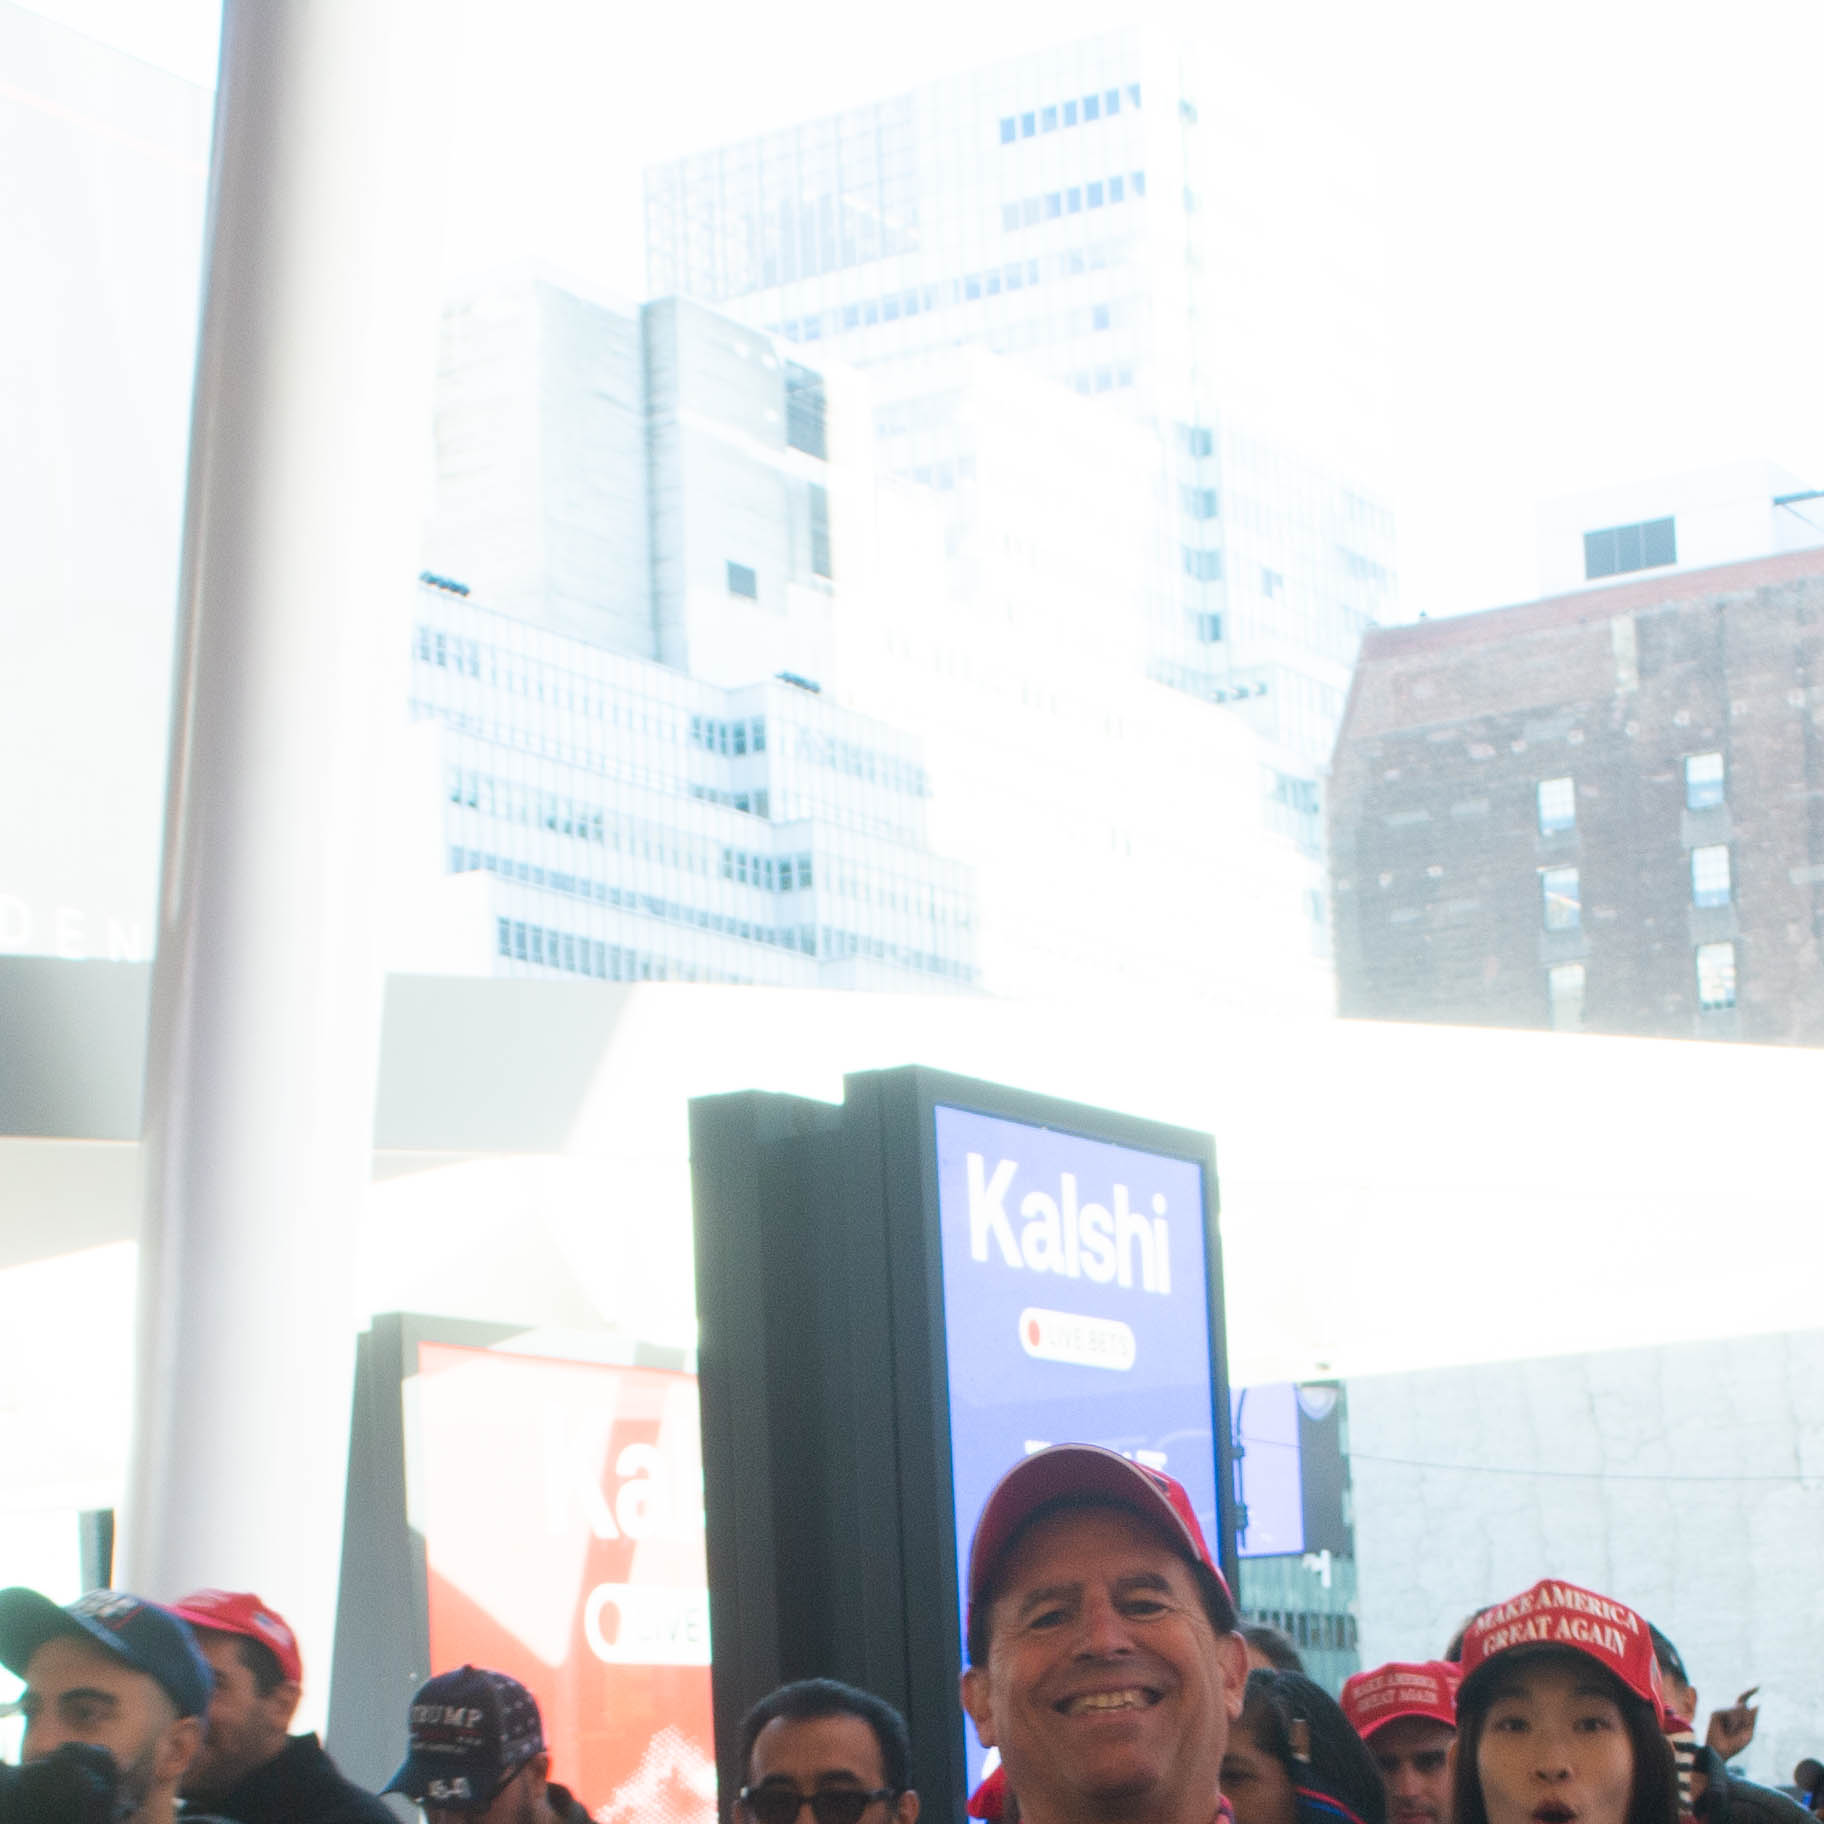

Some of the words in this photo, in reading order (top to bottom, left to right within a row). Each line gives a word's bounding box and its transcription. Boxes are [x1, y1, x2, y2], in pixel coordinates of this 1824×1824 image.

[966, 1151, 1173, 1296] Kalshi
[1476, 1593, 1535, 1636] MAKE
[1535, 1585, 1640, 1636] AMERICA
[1482, 1614, 1552, 1657] GREAT
[1553, 1615, 1627, 1659] AGAIN
